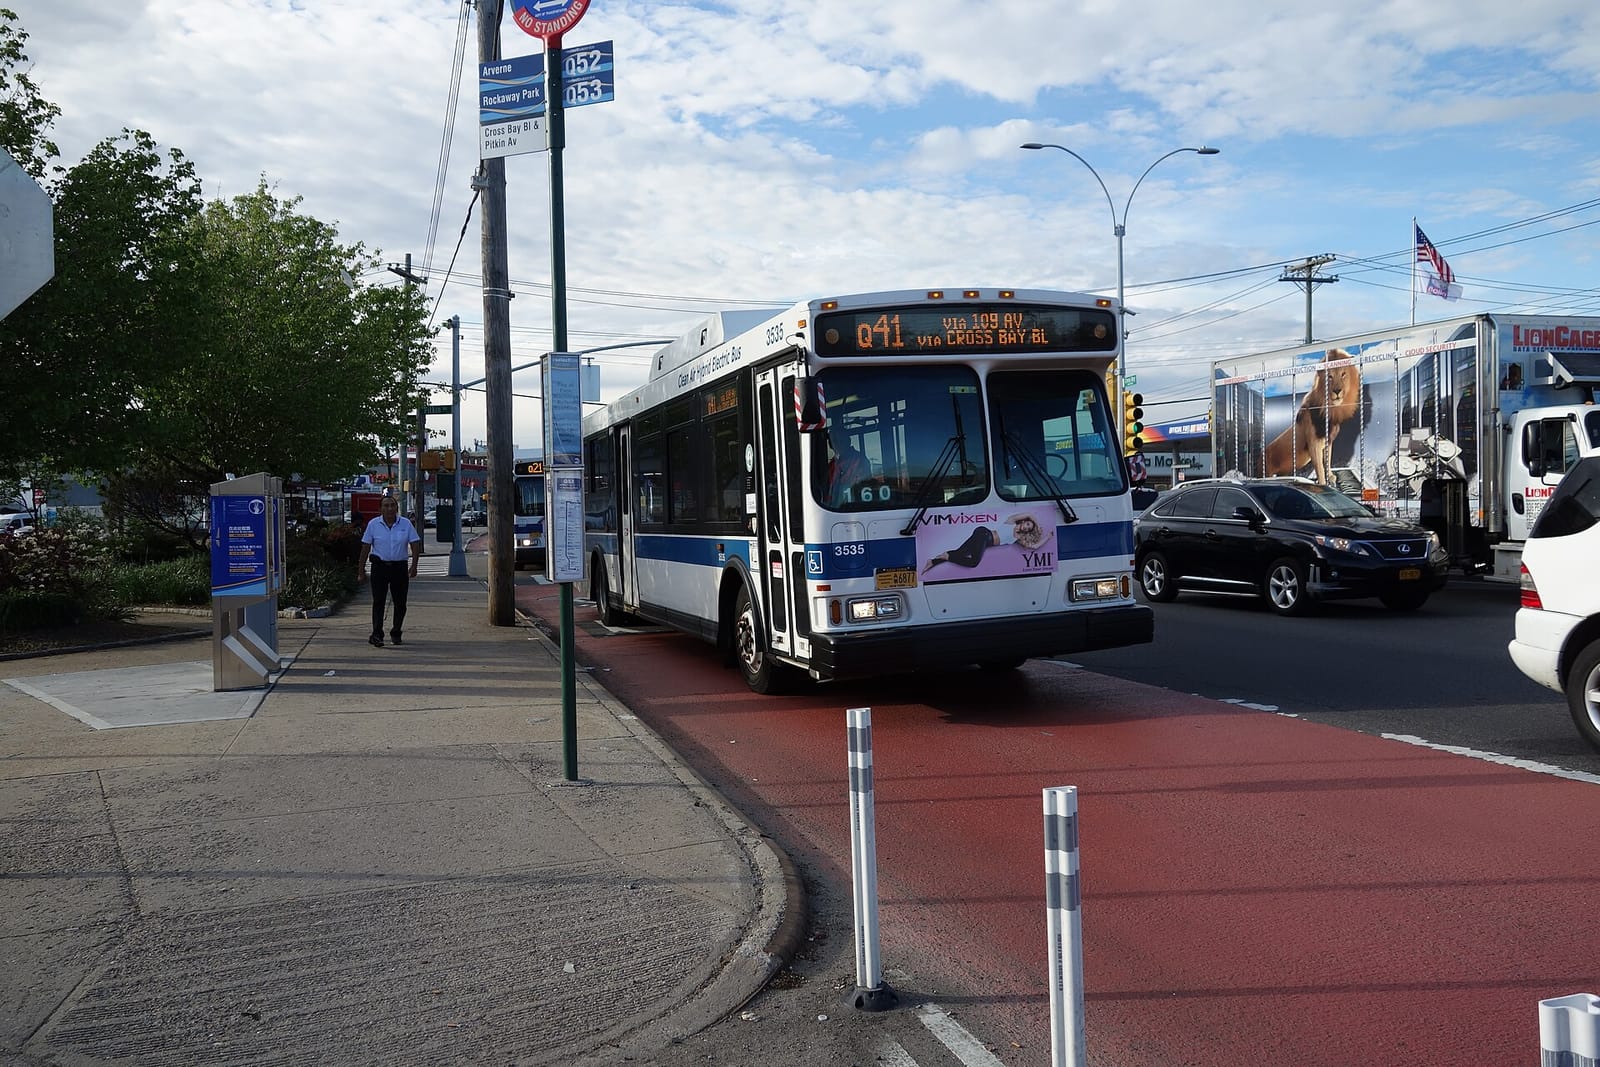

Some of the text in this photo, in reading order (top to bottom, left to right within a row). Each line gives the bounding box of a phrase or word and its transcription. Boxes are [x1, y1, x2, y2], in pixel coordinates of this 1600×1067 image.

[519, 1, 583, 33] NO STANDING
[482, 63, 513, 76] Arverne
[565, 50, 601, 76] Q52
[483, 88, 540, 106] Rockaway Park
[566, 79, 602, 104] Q53
[485, 127, 505, 138] Cross
[508, 124, 521, 135] Bay
[533, 121, 539, 130] &
[485, 137, 517, 150] Pitkin Av
[857, 313, 904, 349] Q41
[971, 312, 998, 331] 109
[1003, 312, 1023, 330] AV
[765, 322, 784, 346] 3535
[946, 330, 993, 346] CROSS
[998, 329, 1026, 345] BAY
[1032, 329, 1049, 345] BL
[677, 371, 689, 389] Clean
[712, 350, 730, 373] Electric
[731, 345, 742, 363] Bus
[1267, 370, 1281, 379] DRIVE
[1283, 366, 1316, 376] DESTRUCTION
[1405, 347, 1425, 357] CLOUD
[1426, 342, 1457, 353] SECURITY
[834, 543, 865, 556] 3535
[1021, 550, 1051, 567] YMI
